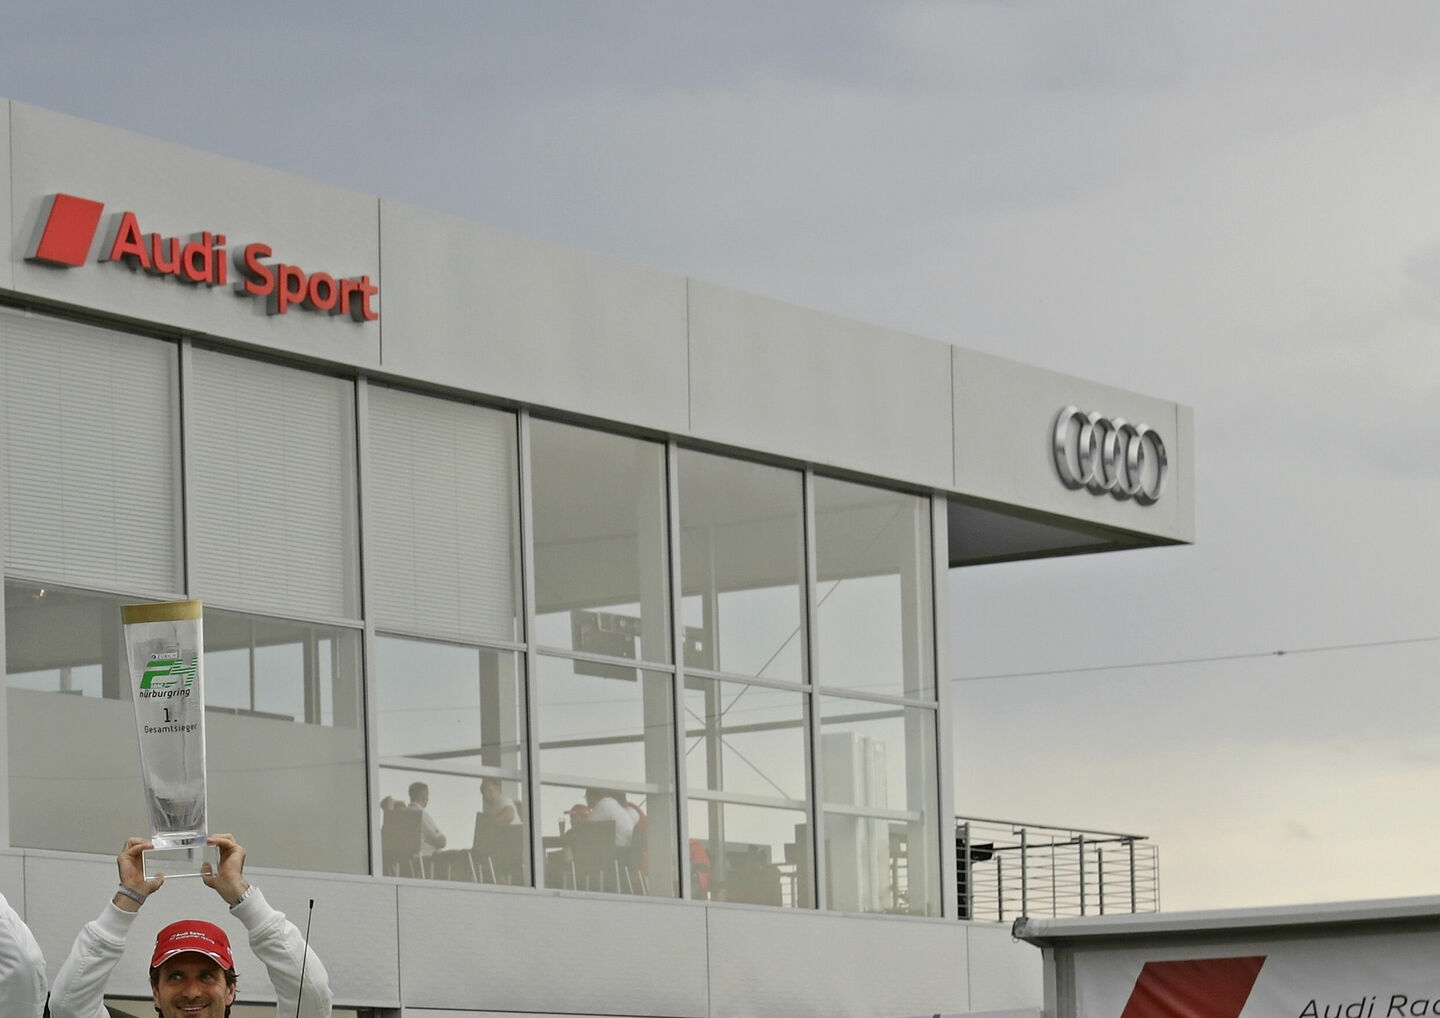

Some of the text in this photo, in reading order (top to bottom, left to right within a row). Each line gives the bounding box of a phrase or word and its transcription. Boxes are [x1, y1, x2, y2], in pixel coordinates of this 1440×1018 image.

[110, 211, 379, 322] Audi Sport
[139, 688, 191, 699] nürburgring
[164, 708, 177, 722] 1.
[144, 724, 198, 733] Gesamtsieger
